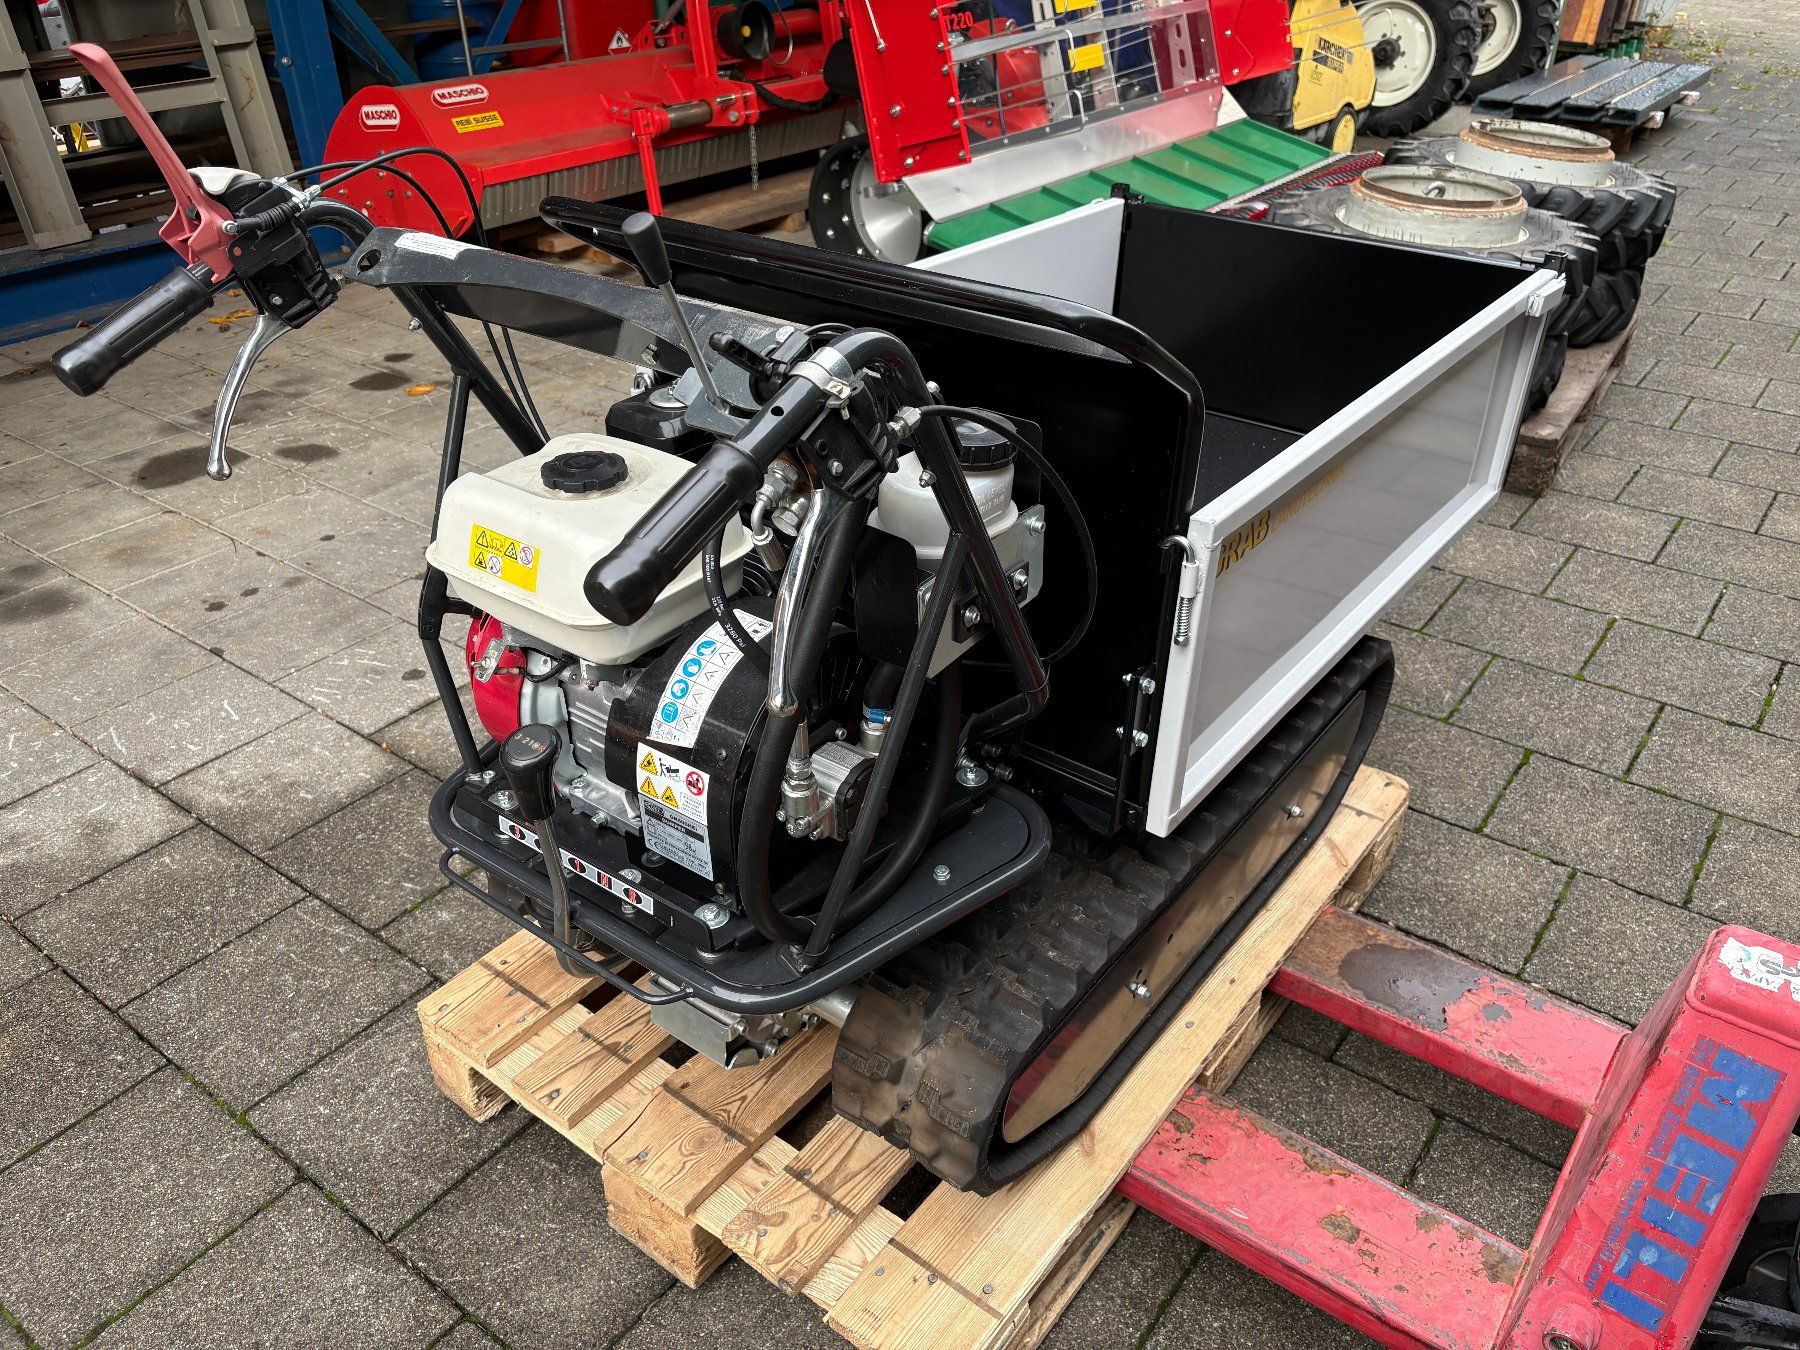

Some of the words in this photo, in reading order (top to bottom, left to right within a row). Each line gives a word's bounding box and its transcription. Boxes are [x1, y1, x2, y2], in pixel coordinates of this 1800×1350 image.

[437, 87, 484, 100] MASCHIO
[363, 110, 397, 121] MASCHIO
[724, 622, 739, 639] 3260
[1600, 1047, 1782, 1332] MEILI
